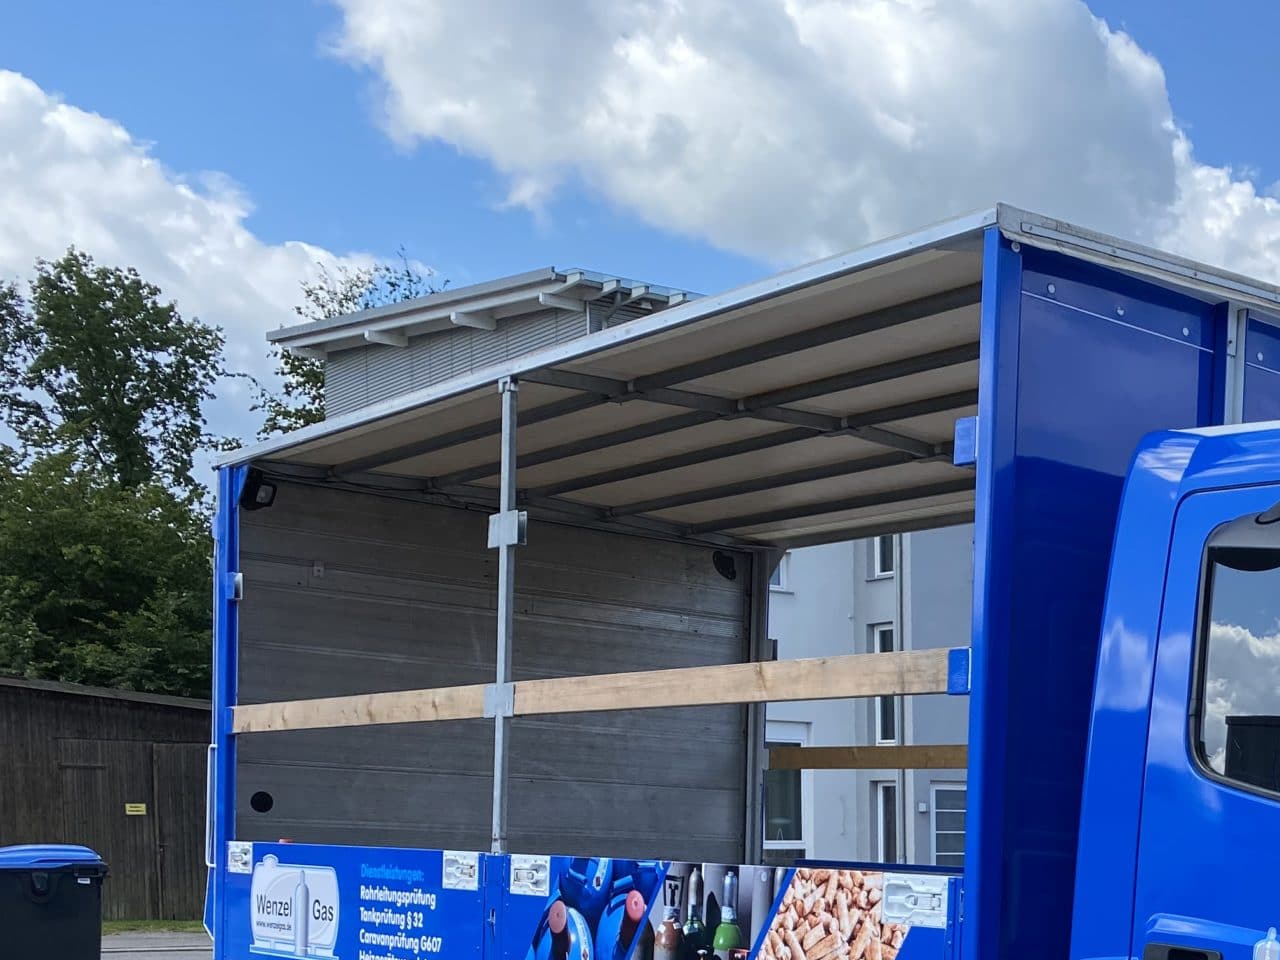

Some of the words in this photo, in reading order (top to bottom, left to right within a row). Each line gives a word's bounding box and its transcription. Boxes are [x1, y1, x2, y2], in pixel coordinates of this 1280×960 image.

[256, 894, 292, 917] Wenzel
[360, 885, 436, 910] Rohrleitungsprüfung
[312, 899, 334, 922] Gas
[360, 906, 405, 930] Tankprüfung
[360, 928, 419, 954] Caravanprüfung
[420, 935, 442, 953] G607
